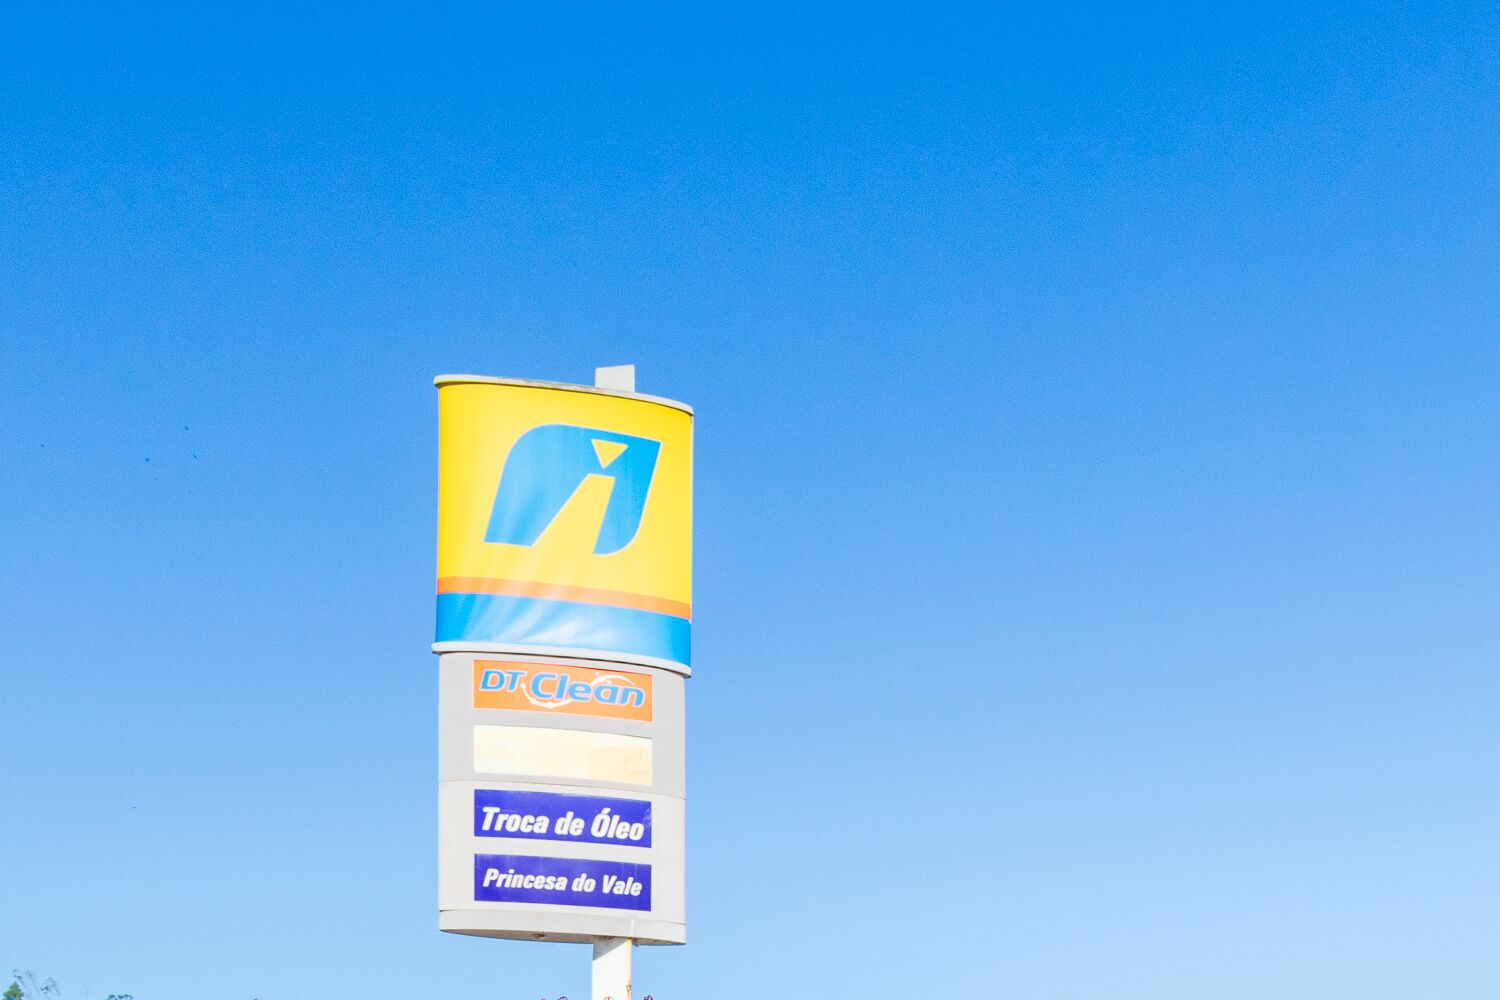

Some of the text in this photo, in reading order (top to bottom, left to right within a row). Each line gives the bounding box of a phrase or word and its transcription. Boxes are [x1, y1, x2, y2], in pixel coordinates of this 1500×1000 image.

[479, 668, 646, 708] DT Clean
[481, 806, 646, 842] Troca de Óleo
[482, 868, 643, 897] Princesa do Vale
